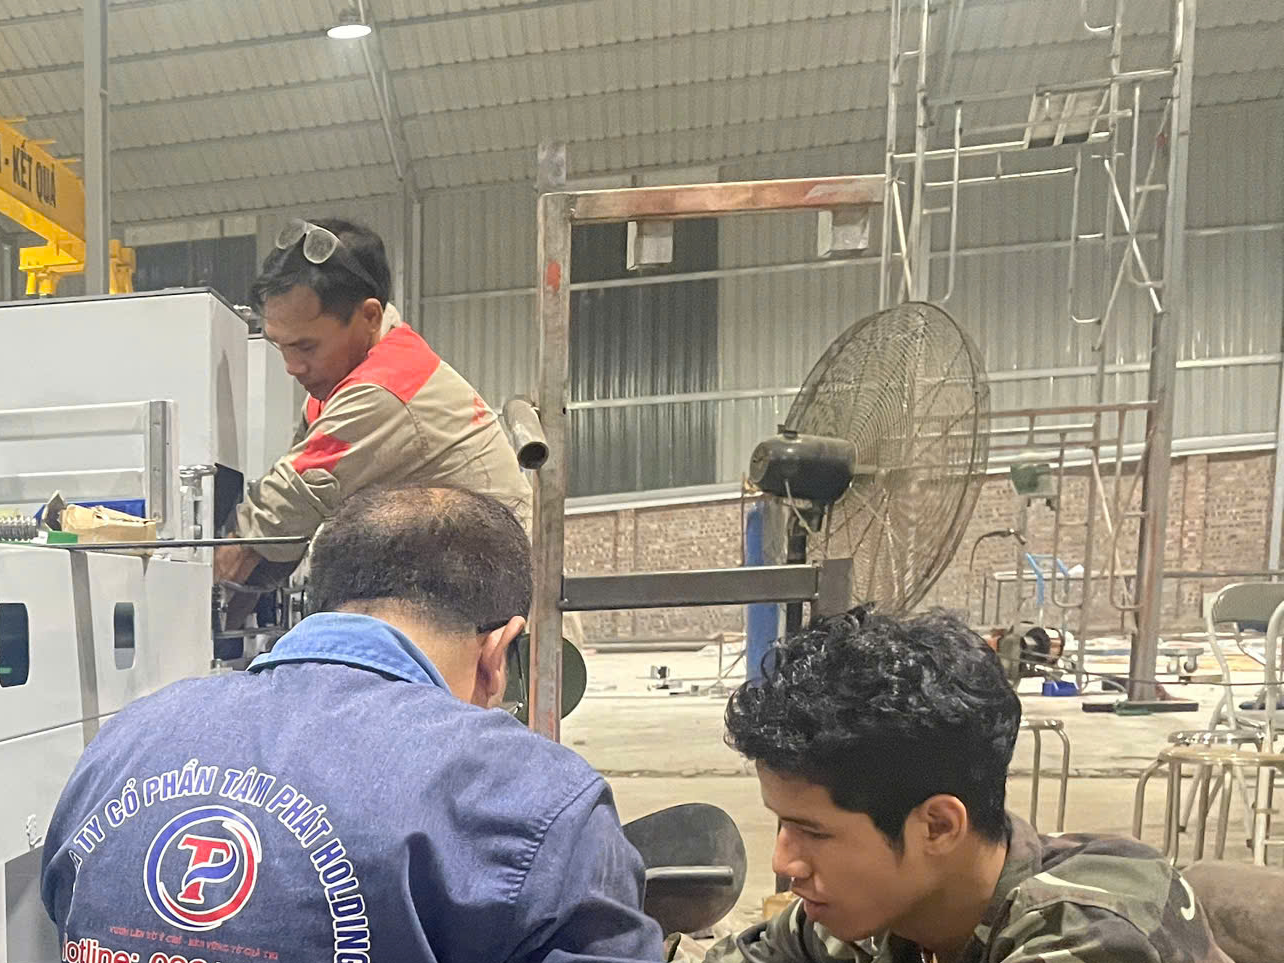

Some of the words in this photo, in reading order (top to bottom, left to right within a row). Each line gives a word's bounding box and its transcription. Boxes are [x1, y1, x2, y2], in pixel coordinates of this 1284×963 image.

[13, 139, 32, 192] KẾT
[74, 815, 105, 853] TY
[105, 778, 140, 828] CỔ
[218, 767, 276, 806] TÂM
[265, 784, 333, 848] PHÁT
